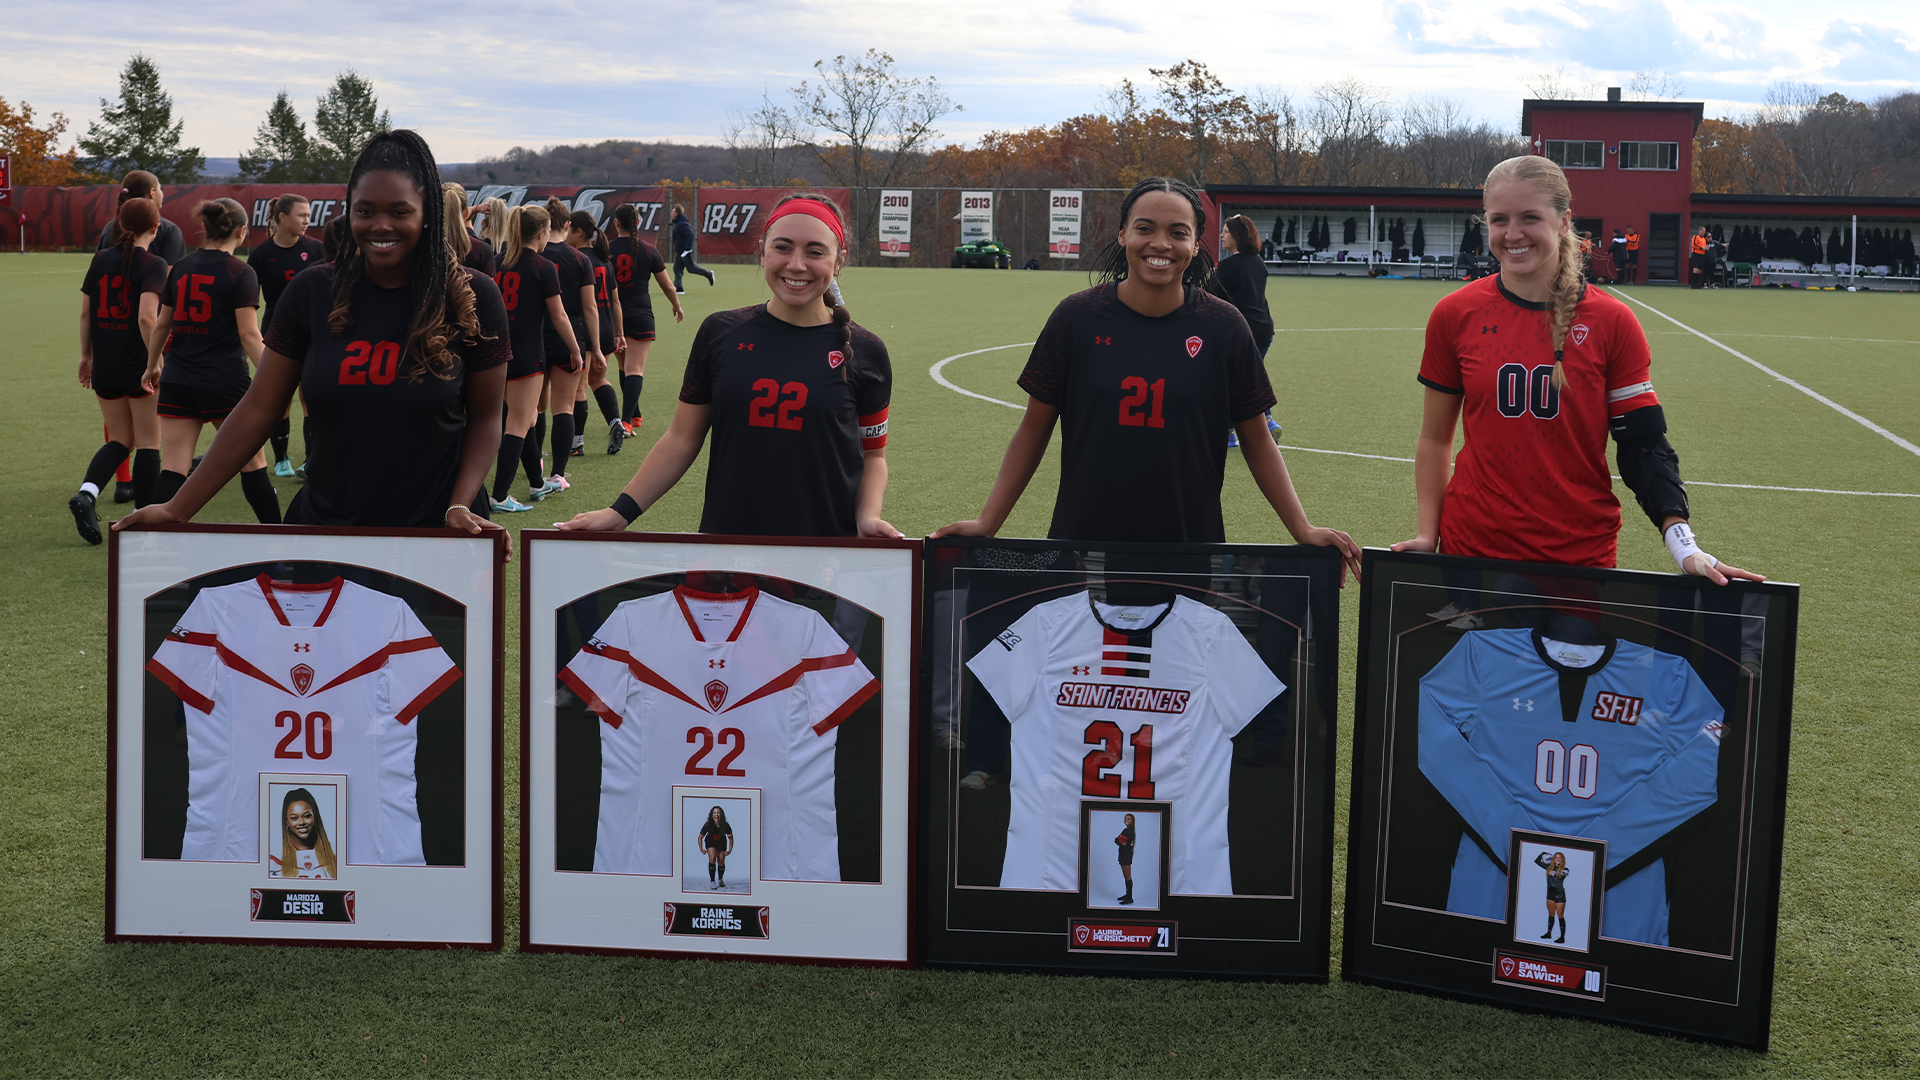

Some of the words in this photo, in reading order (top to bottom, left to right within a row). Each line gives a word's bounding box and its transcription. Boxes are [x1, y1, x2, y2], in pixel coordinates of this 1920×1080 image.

[883, 196, 909, 207] 2010
[964, 198, 990, 208] 2013
[1052, 196, 1079, 208] 2016
[625, 203, 662, 230] ST.
[702, 204, 757, 233] 1847
[616, 254, 632, 282] 8
[97, 274, 131, 320] 13
[174, 274, 216, 322] 15
[338, 340, 401, 385] 20
[748, 378, 809, 432] 22
[1118, 376, 1166, 428] 21
[1496, 362, 1561, 420] 00
[1057, 682, 1111, 708] SAINT
[1109, 685, 1190, 713] FRANCIS
[274, 710, 332, 760] 20
[685, 726, 746, 777] 22
[1081, 720, 1155, 800] 21
[1534, 738, 1599, 800] 00
[283, 901, 324, 914] DESIR
[700, 908, 734, 918] RAINE
[692, 918, 742, 930] KORPICS
[1157, 927, 1169, 947] 21
[1093, 934, 1152, 943] PERSICHETTY
[1518, 961, 1547, 972] EMMA
[1518, 969, 1564, 984] SAWICH
[1584, 970, 1600, 992] 00
